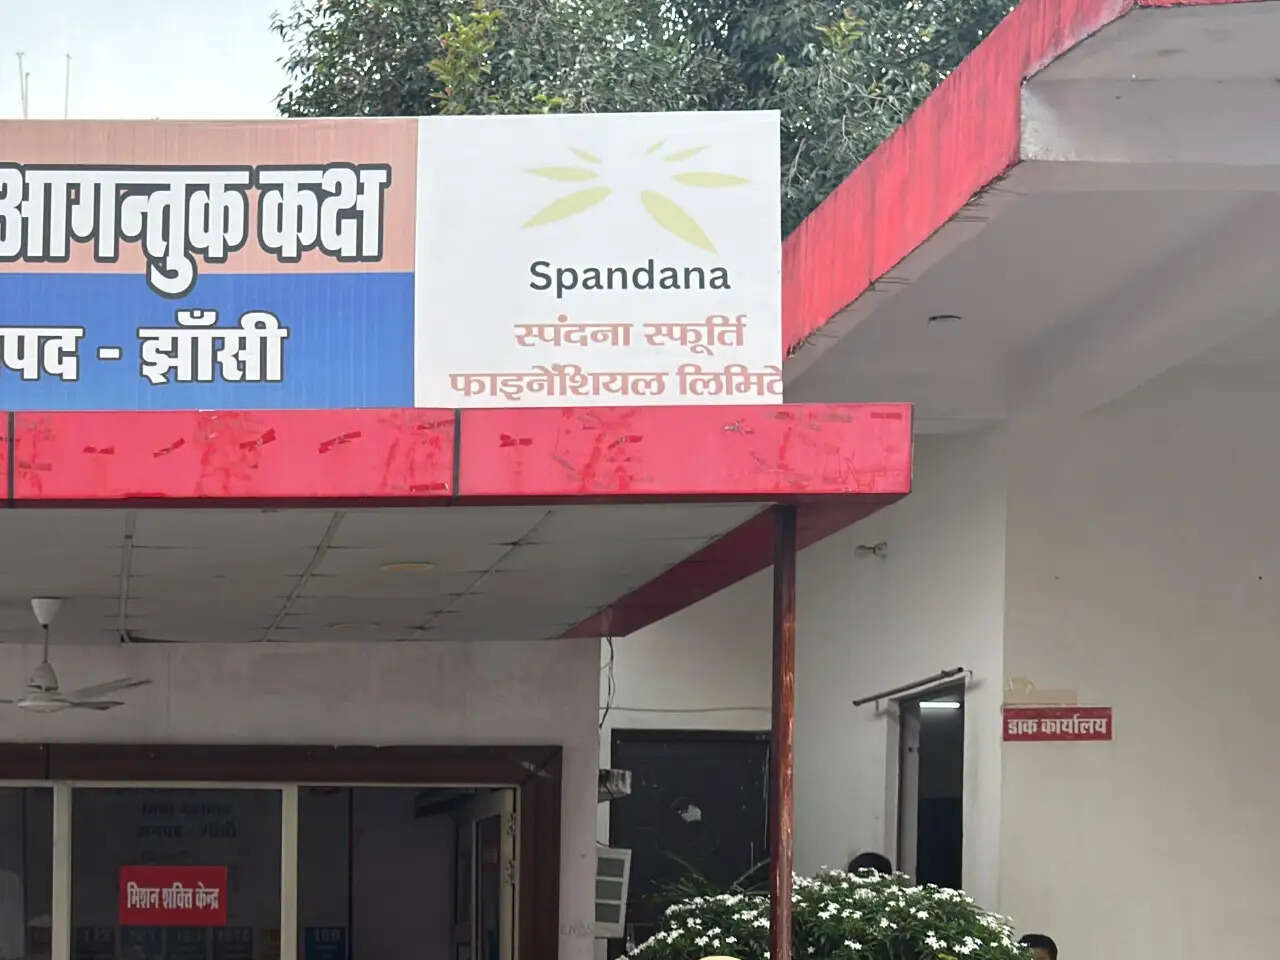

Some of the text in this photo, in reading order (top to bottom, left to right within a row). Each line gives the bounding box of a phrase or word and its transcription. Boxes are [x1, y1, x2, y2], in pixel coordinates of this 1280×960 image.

[255, 164, 391, 262] कक्ष
[529, 259, 731, 298] Spandana
[514, 314, 747, 356] स्पंदना स्फूर्ति
[448, 363, 669, 400] फाइनेंशियल
[1008, 714, 1108, 735] डाक कार्यालय
[127, 881, 220, 910] मिशन शक्ति केन्द्र
